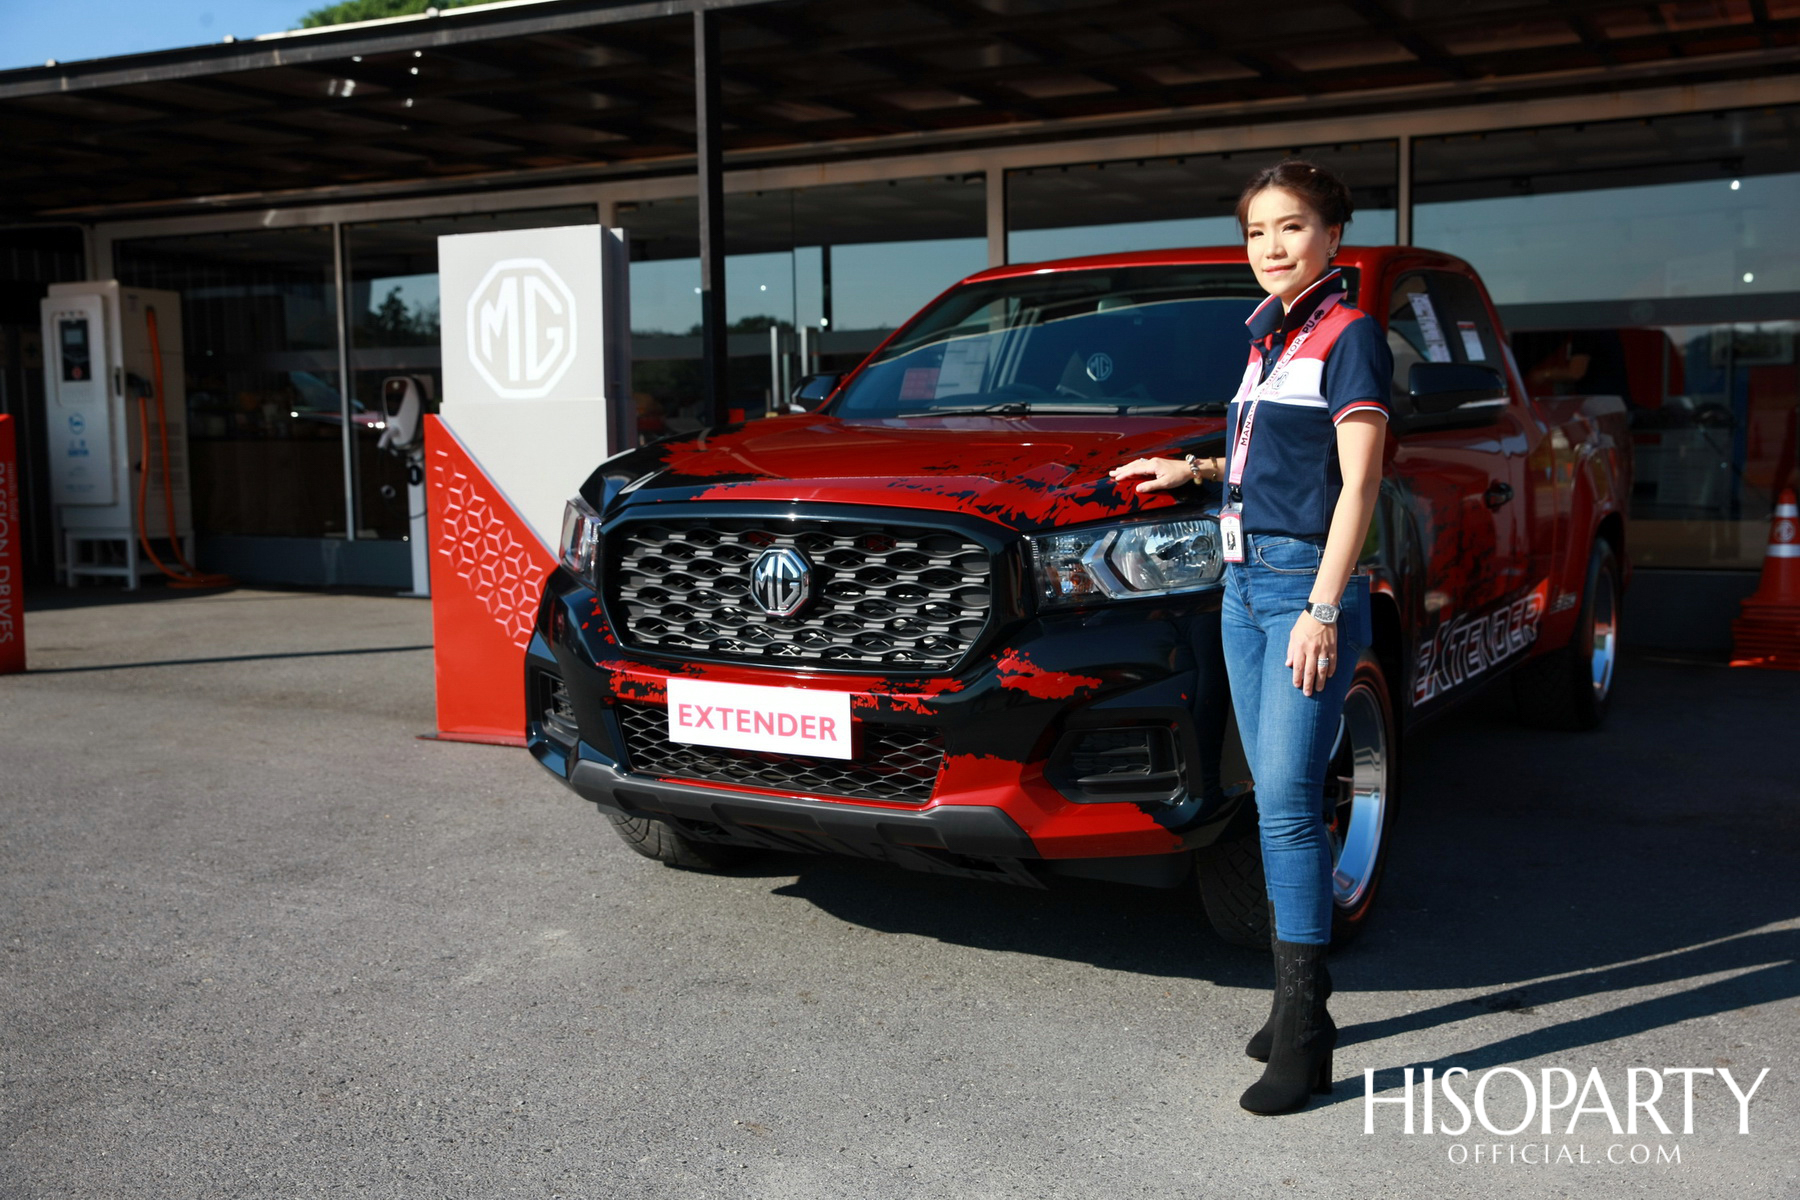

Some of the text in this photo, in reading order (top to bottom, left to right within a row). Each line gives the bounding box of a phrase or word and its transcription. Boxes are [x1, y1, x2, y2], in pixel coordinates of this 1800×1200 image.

[479, 274, 565, 383] MG
[1240, 387, 1265, 447] MANA
[0, 565, 14, 643] DRIVES
[754, 553, 803, 612] MG
[1412, 593, 1545, 708] EXTENDER
[678, 703, 838, 742] EXTENDER
